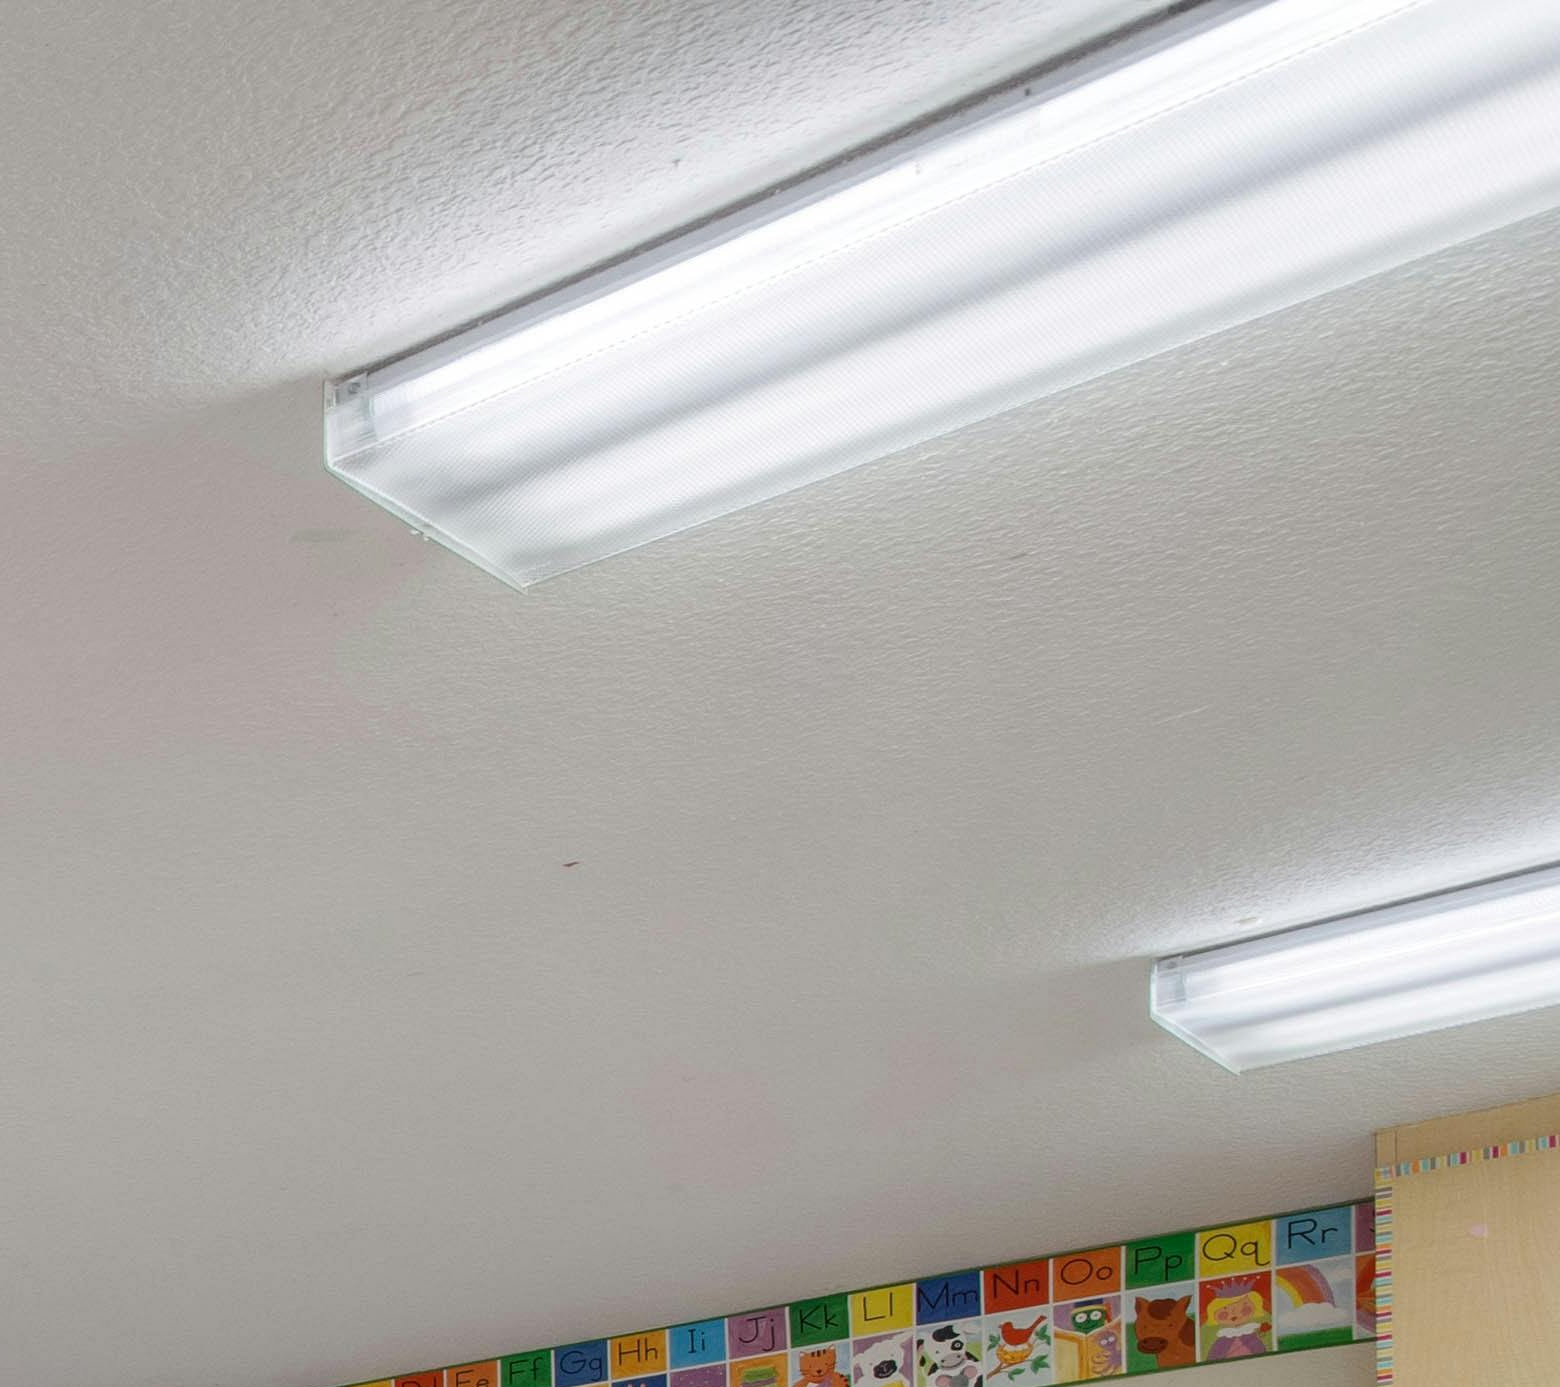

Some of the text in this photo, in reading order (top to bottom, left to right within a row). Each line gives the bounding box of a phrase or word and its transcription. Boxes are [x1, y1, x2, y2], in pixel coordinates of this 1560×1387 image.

[508, 1356, 541, 1386] Ff
[560, 1350, 603, 1382] Gg
[618, 1338, 659, 1367] Hh
[687, 1328, 706, 1354] Ii
[738, 1316, 776, 1351] Jj
[799, 1305, 839, 1334] Kk
[862, 1297, 894, 1321] Ll
[919, 1287, 978, 1313] Mm
[992, 1271, 1042, 1299] Nn
[1060, 1258, 1114, 1285] Oo
[1134, 1246, 1183, 1282] Pp
[1202, 1233, 1271, 1267] Qq
[1287, 1218, 1340, 1250] Rr
